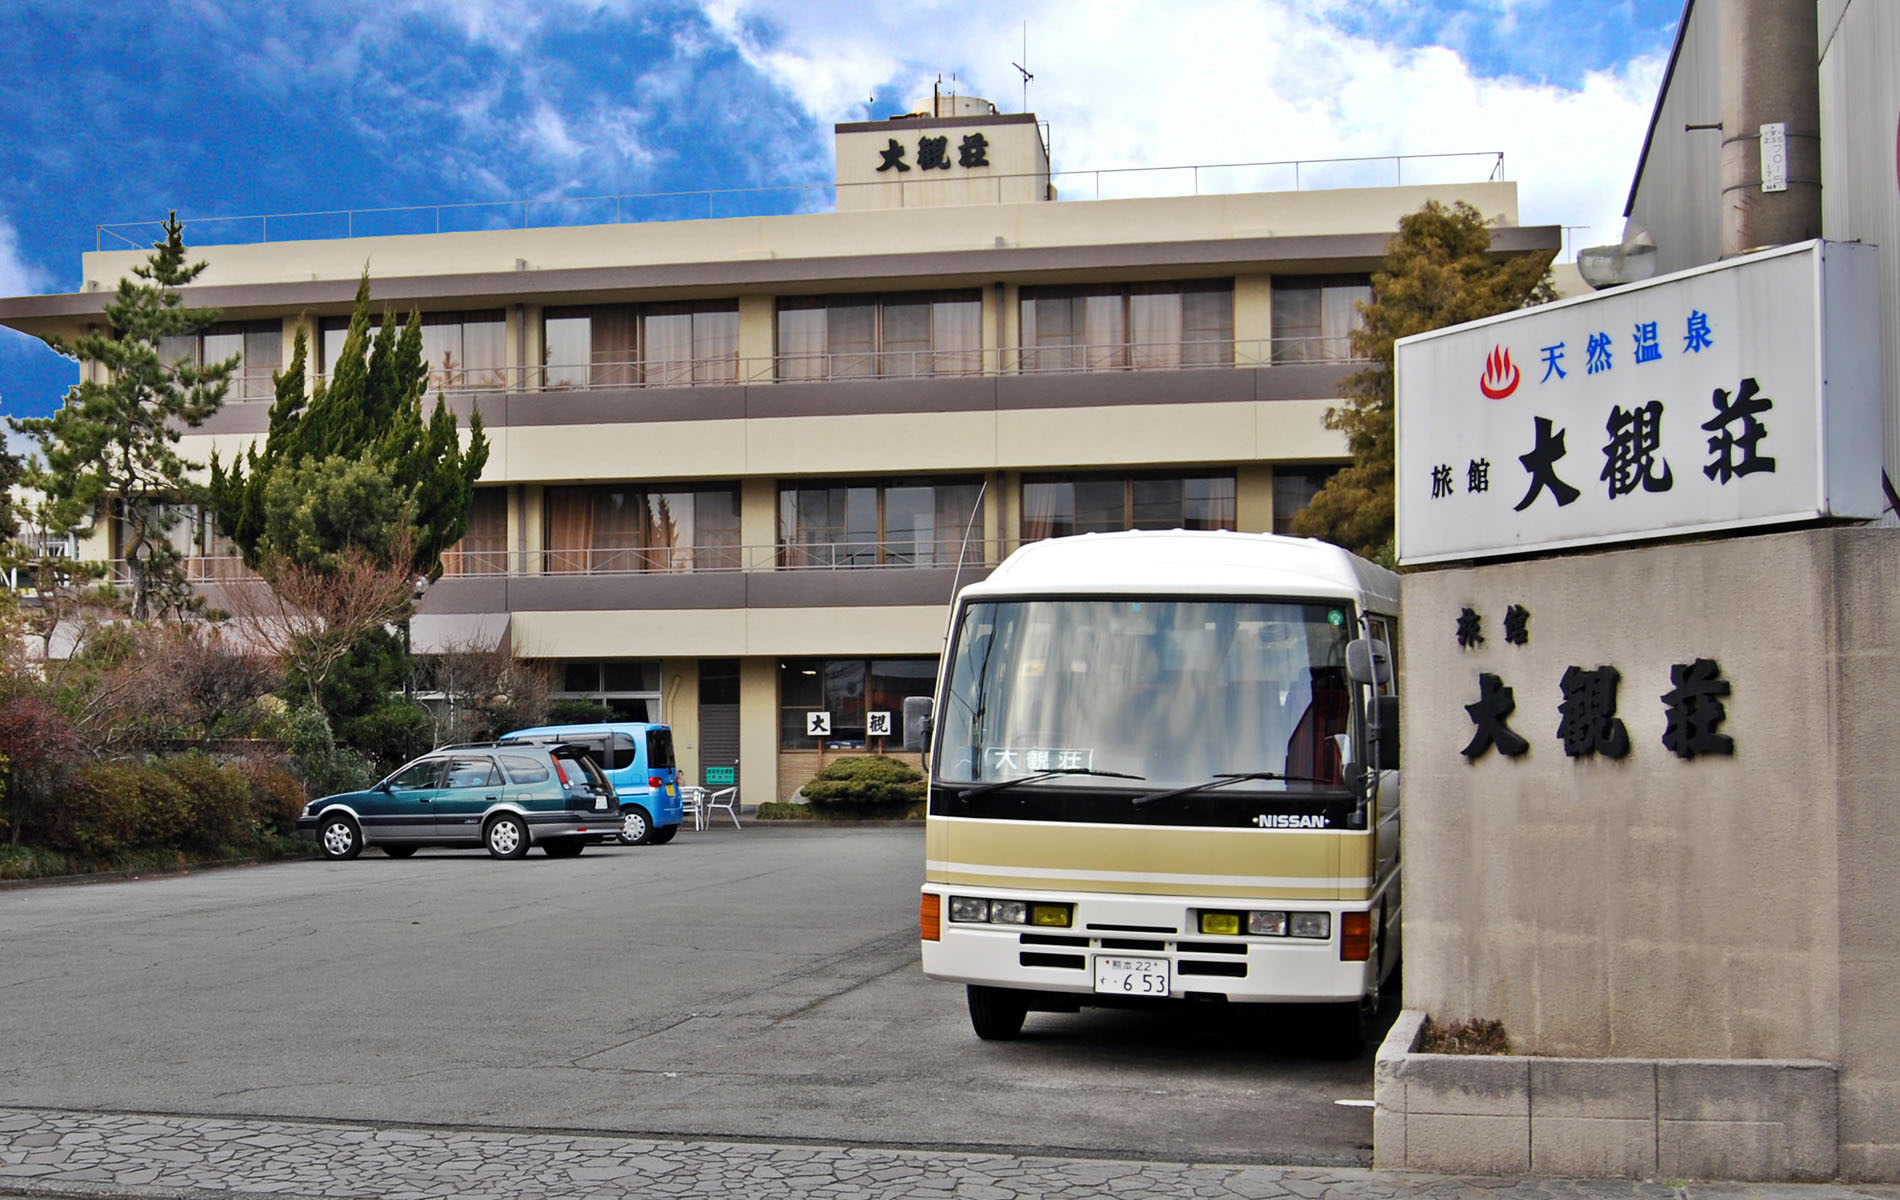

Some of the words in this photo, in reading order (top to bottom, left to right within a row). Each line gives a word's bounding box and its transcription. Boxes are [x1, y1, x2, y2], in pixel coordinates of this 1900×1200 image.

[876, 133, 989, 172] 大観荘
[1541, 310, 1713, 383] 天然温泉
[1430, 458, 1491, 500] 旅館
[1513, 378, 1776, 512] 大観荘
[1456, 604, 1531, 648] 旅館
[811, 715, 828, 732] 大
[869, 714, 888, 733] 観
[1460, 658, 1734, 760] 大観荘
[994, 749, 1082, 770] 大観荘
[1259, 814, 1325, 828] NISSAN
[1135, 961, 1151, 971] 22
